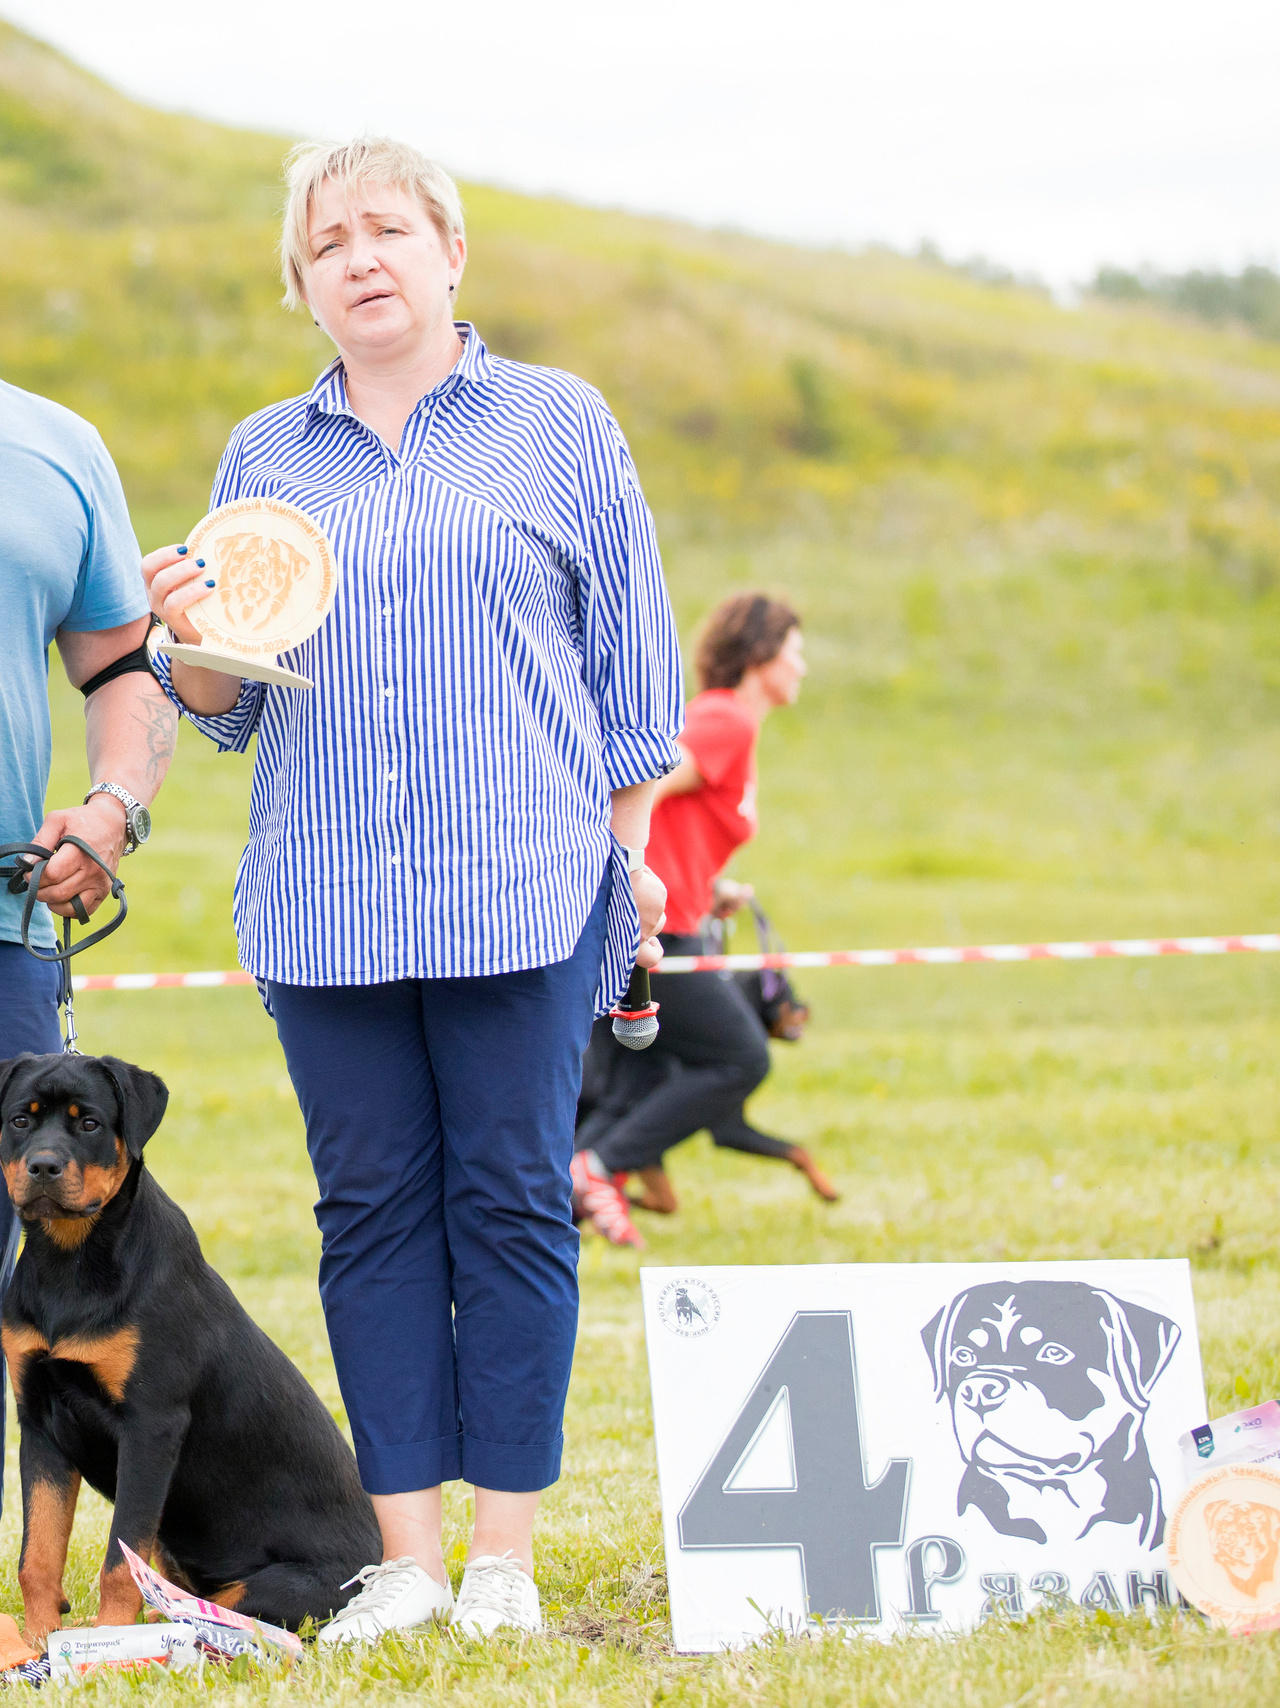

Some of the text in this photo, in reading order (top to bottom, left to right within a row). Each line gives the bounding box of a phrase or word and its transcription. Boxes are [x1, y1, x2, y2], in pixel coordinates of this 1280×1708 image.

[185, 500, 334, 612] ежрегиональный Чемпионат Ротвейлеров
[225, 637, 261, 655] Рязани
[684, 1279, 706, 1289] КЛУБ
[708, 1289, 721, 1321] РОССИИ
[676, 1310, 914, 1624] 4
